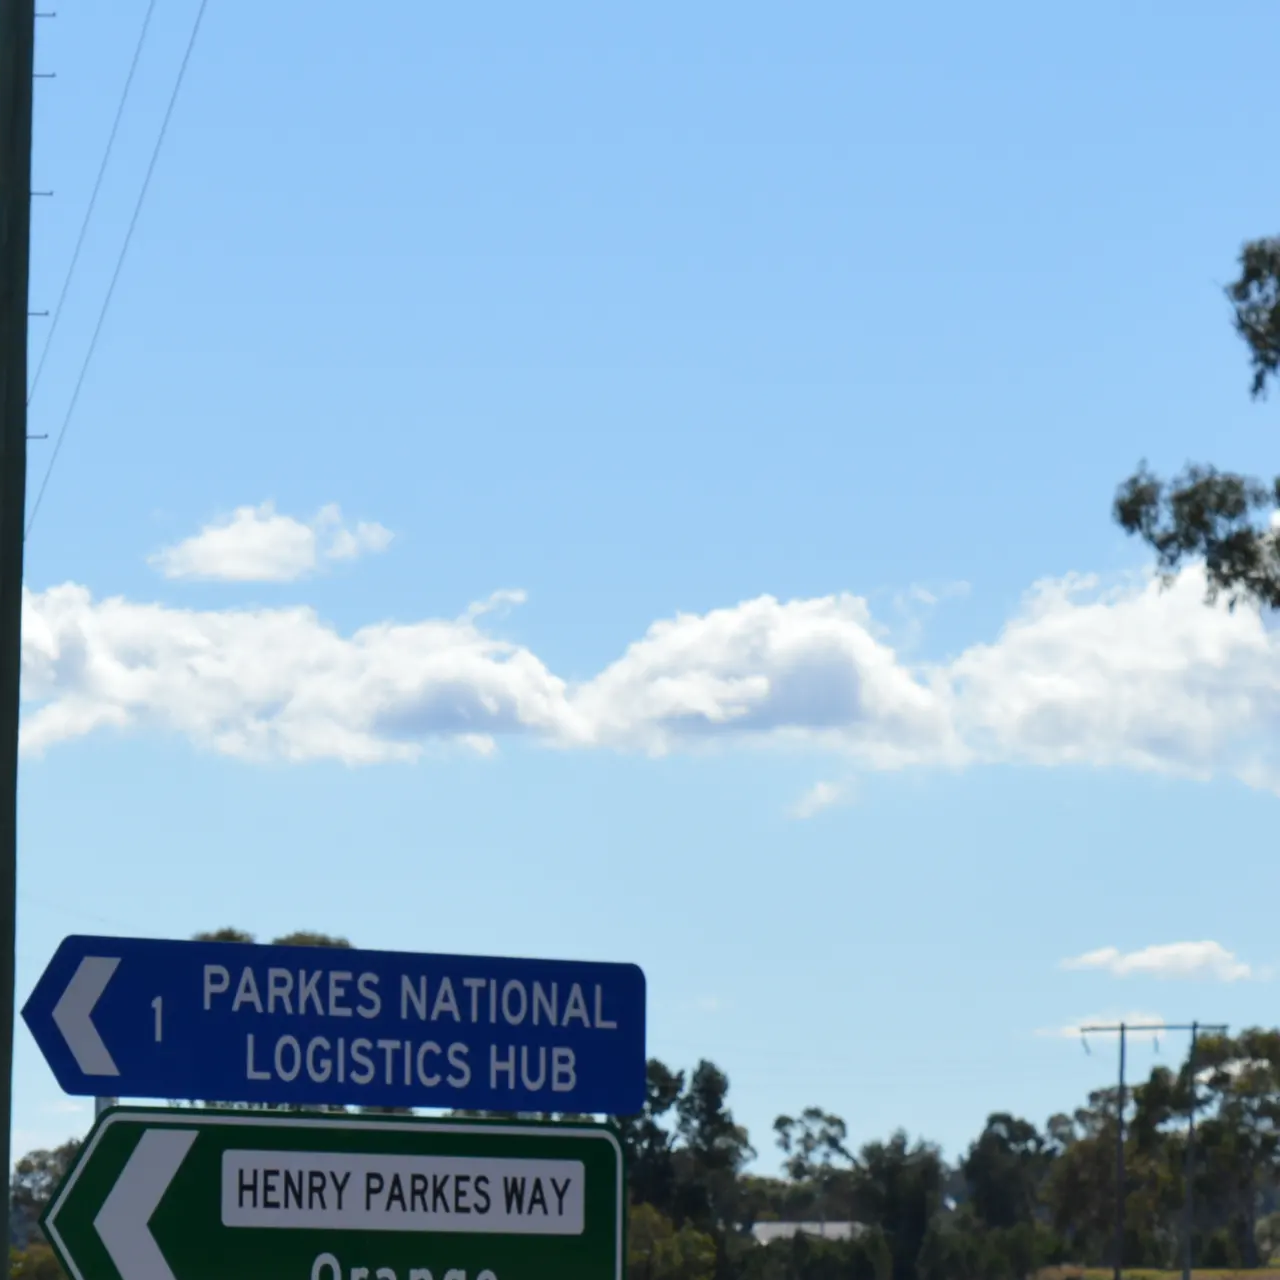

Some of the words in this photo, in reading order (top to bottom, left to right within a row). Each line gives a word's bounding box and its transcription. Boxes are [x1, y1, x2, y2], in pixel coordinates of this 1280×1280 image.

[150, 996, 162, 1042] 1
[203, 964, 382, 1019] PARKES
[399, 974, 618, 1030] NATIONAL
[246, 1033, 472, 1088] LOGISTICS
[489, 1045, 578, 1093] HUB
[238, 1168, 352, 1211] HENRY
[365, 1172, 491, 1215] PARKES
[502, 1176, 572, 1217] WAY
